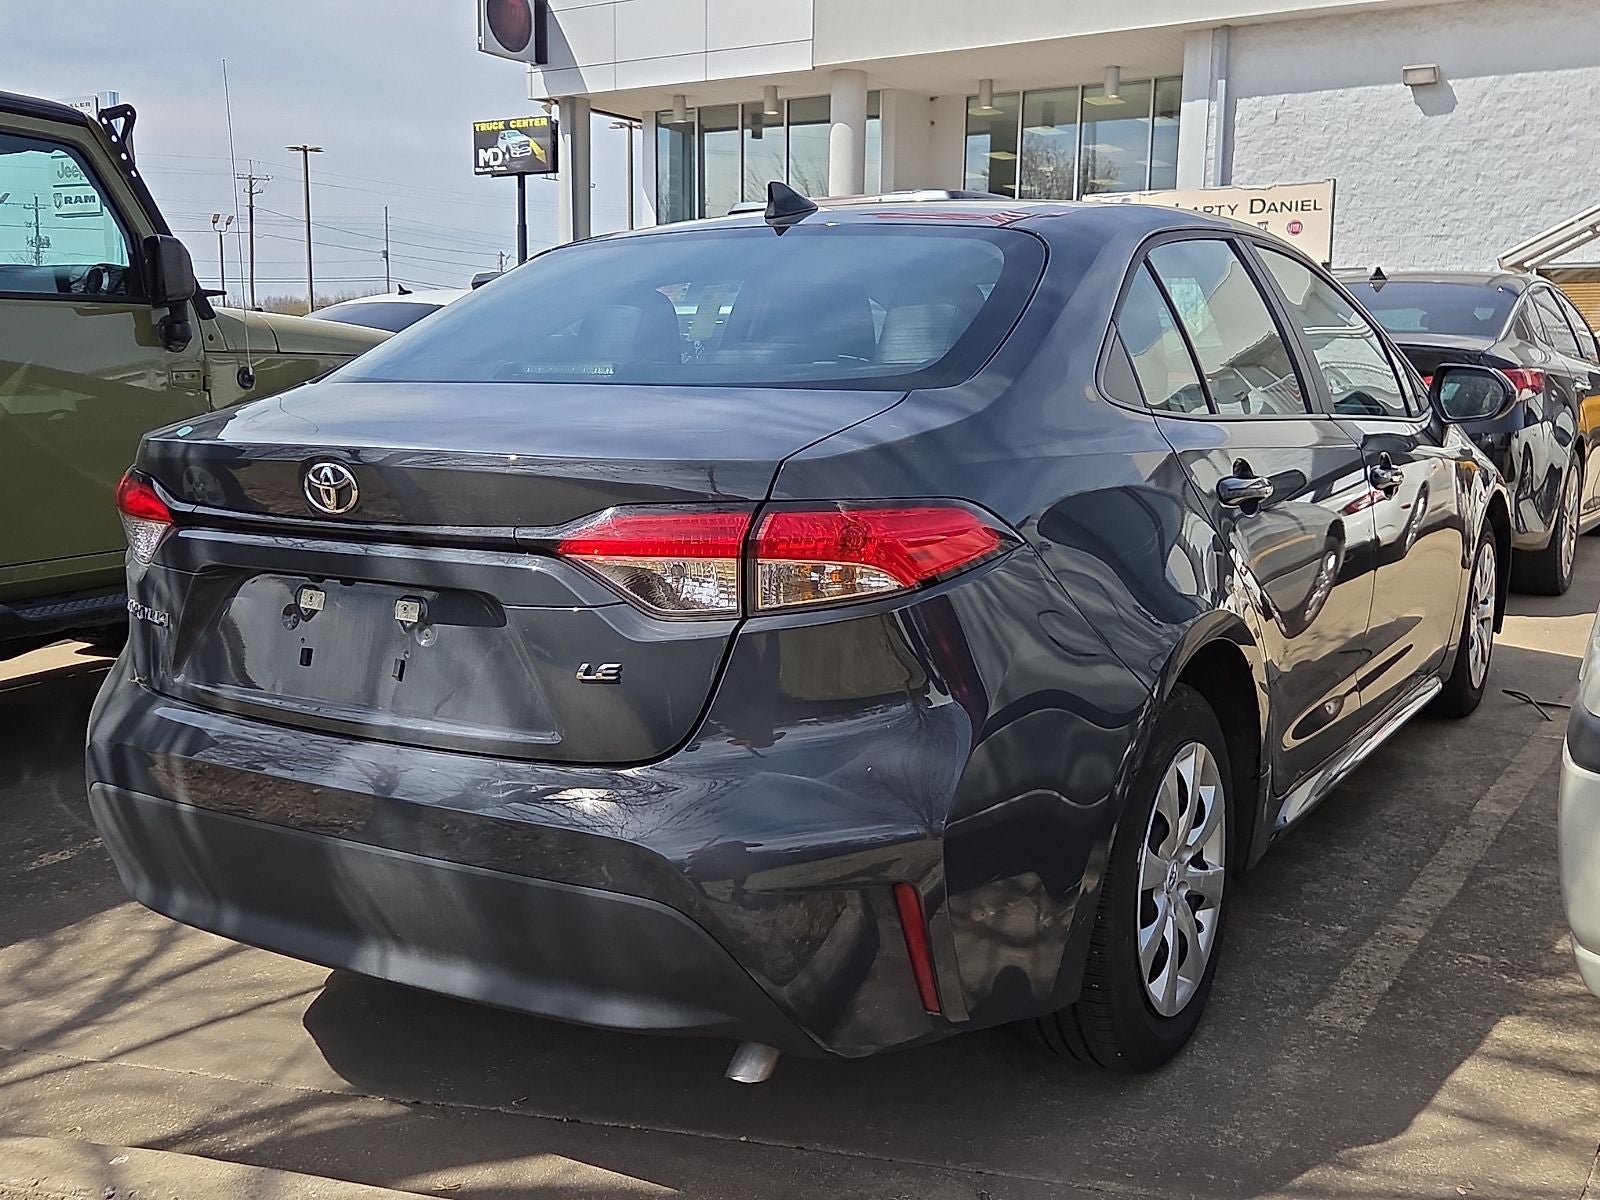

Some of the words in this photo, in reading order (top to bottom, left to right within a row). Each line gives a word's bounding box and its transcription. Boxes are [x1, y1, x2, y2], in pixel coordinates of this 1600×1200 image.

[474, 121, 505, 132] TRUCK
[509, 117, 548, 128] CENTER
[478, 147, 503, 167] MD
[64, 195, 96, 205] RAM
[1248, 198, 1323, 214] DANIEL
[576, 662, 623, 682] LE
